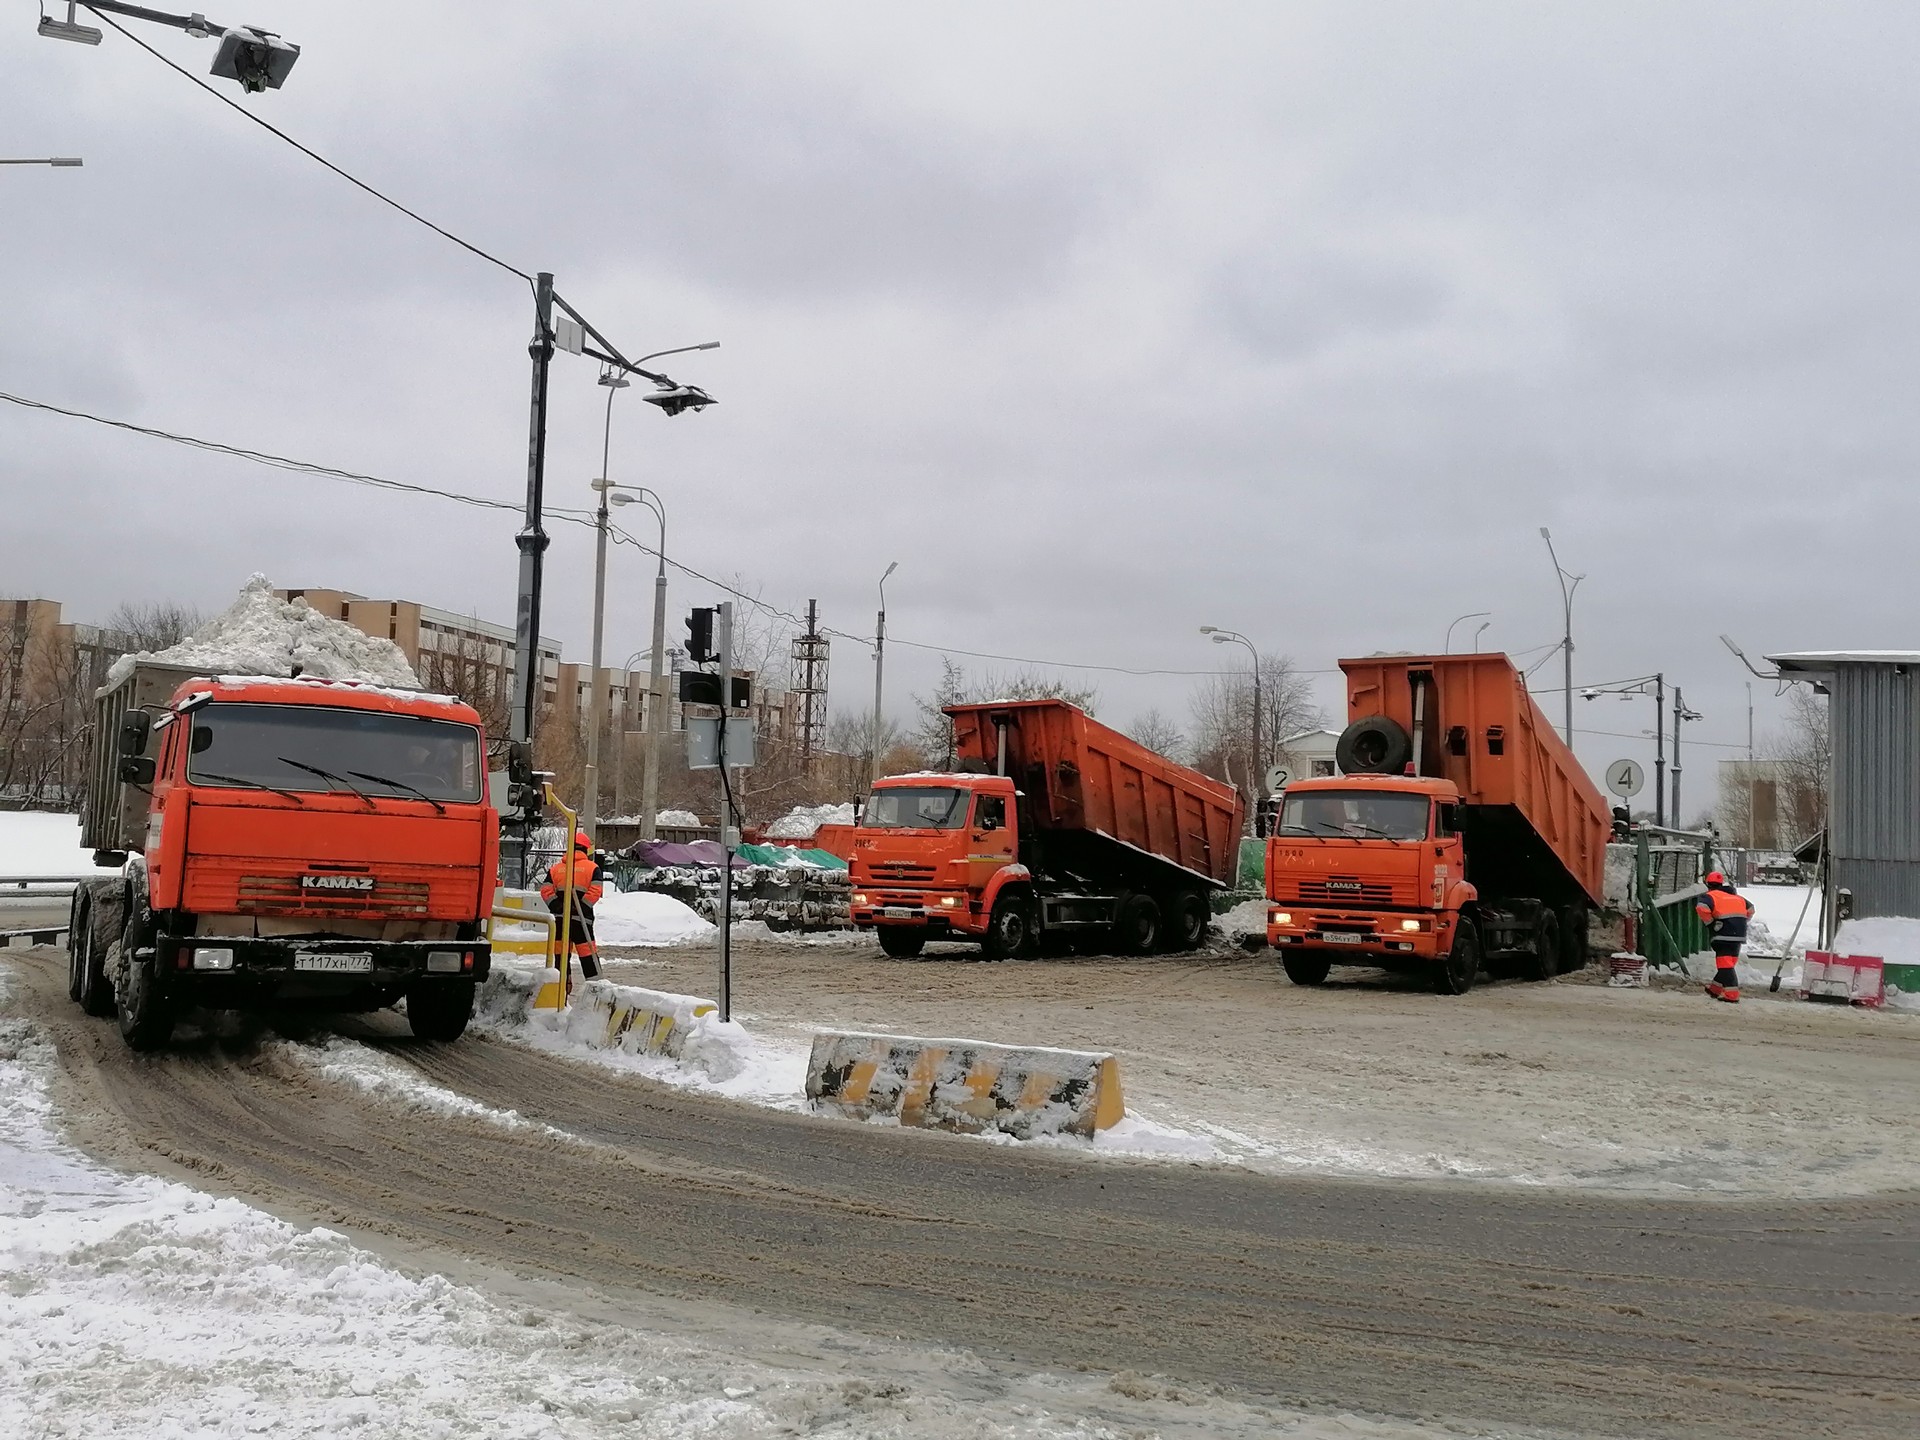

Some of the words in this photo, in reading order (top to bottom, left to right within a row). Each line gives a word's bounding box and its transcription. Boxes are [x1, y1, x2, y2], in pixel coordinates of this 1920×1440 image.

[1275, 770, 1287, 790] 2
[1618, 766, 1633, 789] 4
[302, 876, 373, 890] KAMAZ
[1326, 882, 1361, 890] KAMAZ
